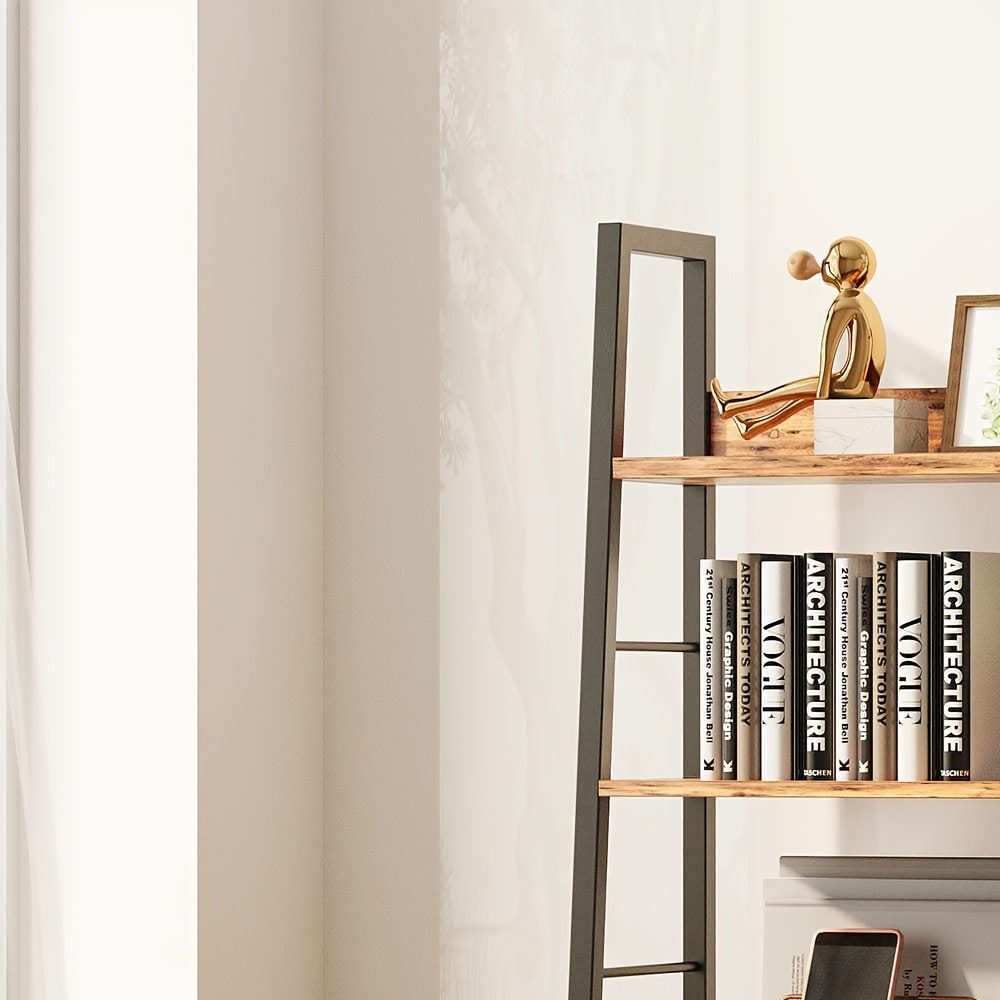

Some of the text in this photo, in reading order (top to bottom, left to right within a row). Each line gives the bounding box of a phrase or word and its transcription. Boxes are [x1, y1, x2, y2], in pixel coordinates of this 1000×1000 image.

[705, 592, 714, 634] Century
[840, 592, 849, 634] Century
[723, 631, 734, 689] Graphic
[740, 562, 751, 726] ARCHITECTS TODAY
[806, 557, 826, 752] ARCHITECTURE
[841, 636, 849, 669] House
[859, 630, 870, 688] Graphic
[876, 561, 887, 726] ARCHITECTS TODAY
[943, 556, 963, 753] ARCHITECTURE
[762, 617, 785, 725] VOGUE
[898, 616, 922, 725] VOGUE
[723, 692, 733, 741] Design
[841, 672, 849, 719] Jonathan
[859, 692, 869, 741] Design
[841, 723, 849, 743] Bell
[902, 969, 912, 980] by
[929, 944, 938, 969] HOW
[929, 973, 937, 987] TO
